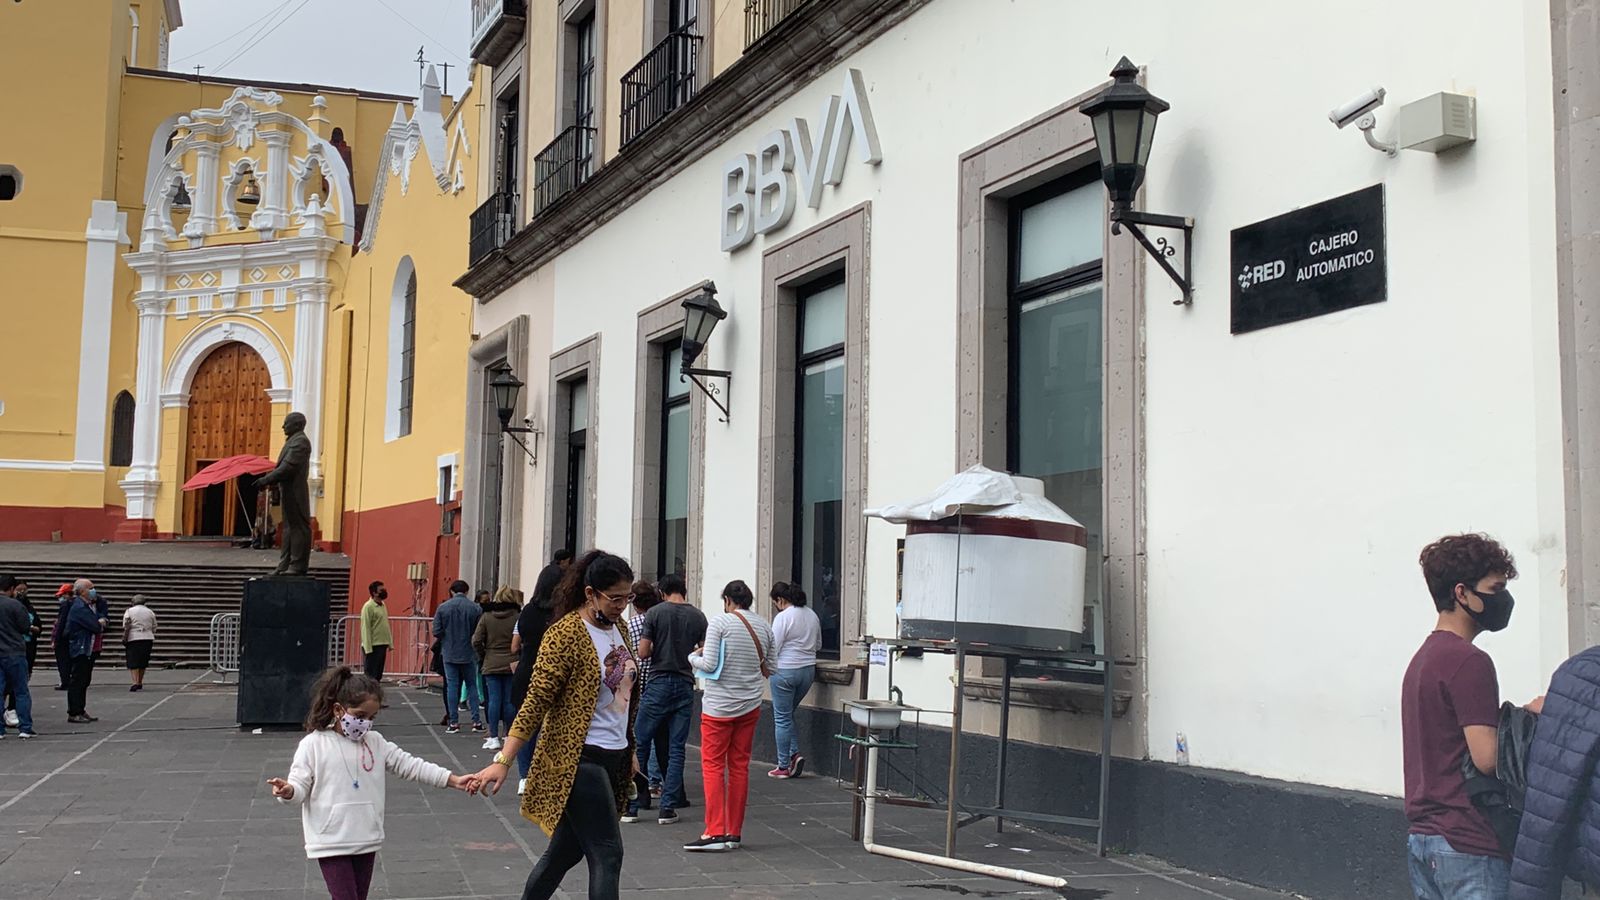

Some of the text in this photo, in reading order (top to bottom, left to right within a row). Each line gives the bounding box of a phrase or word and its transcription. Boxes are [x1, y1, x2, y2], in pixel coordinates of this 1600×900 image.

[721, 68, 882, 252] BBVA
[1309, 230, 1358, 256] CAJERO
[1253, 260, 1286, 285] RED
[1296, 249, 1374, 282] AUTOMATICO
